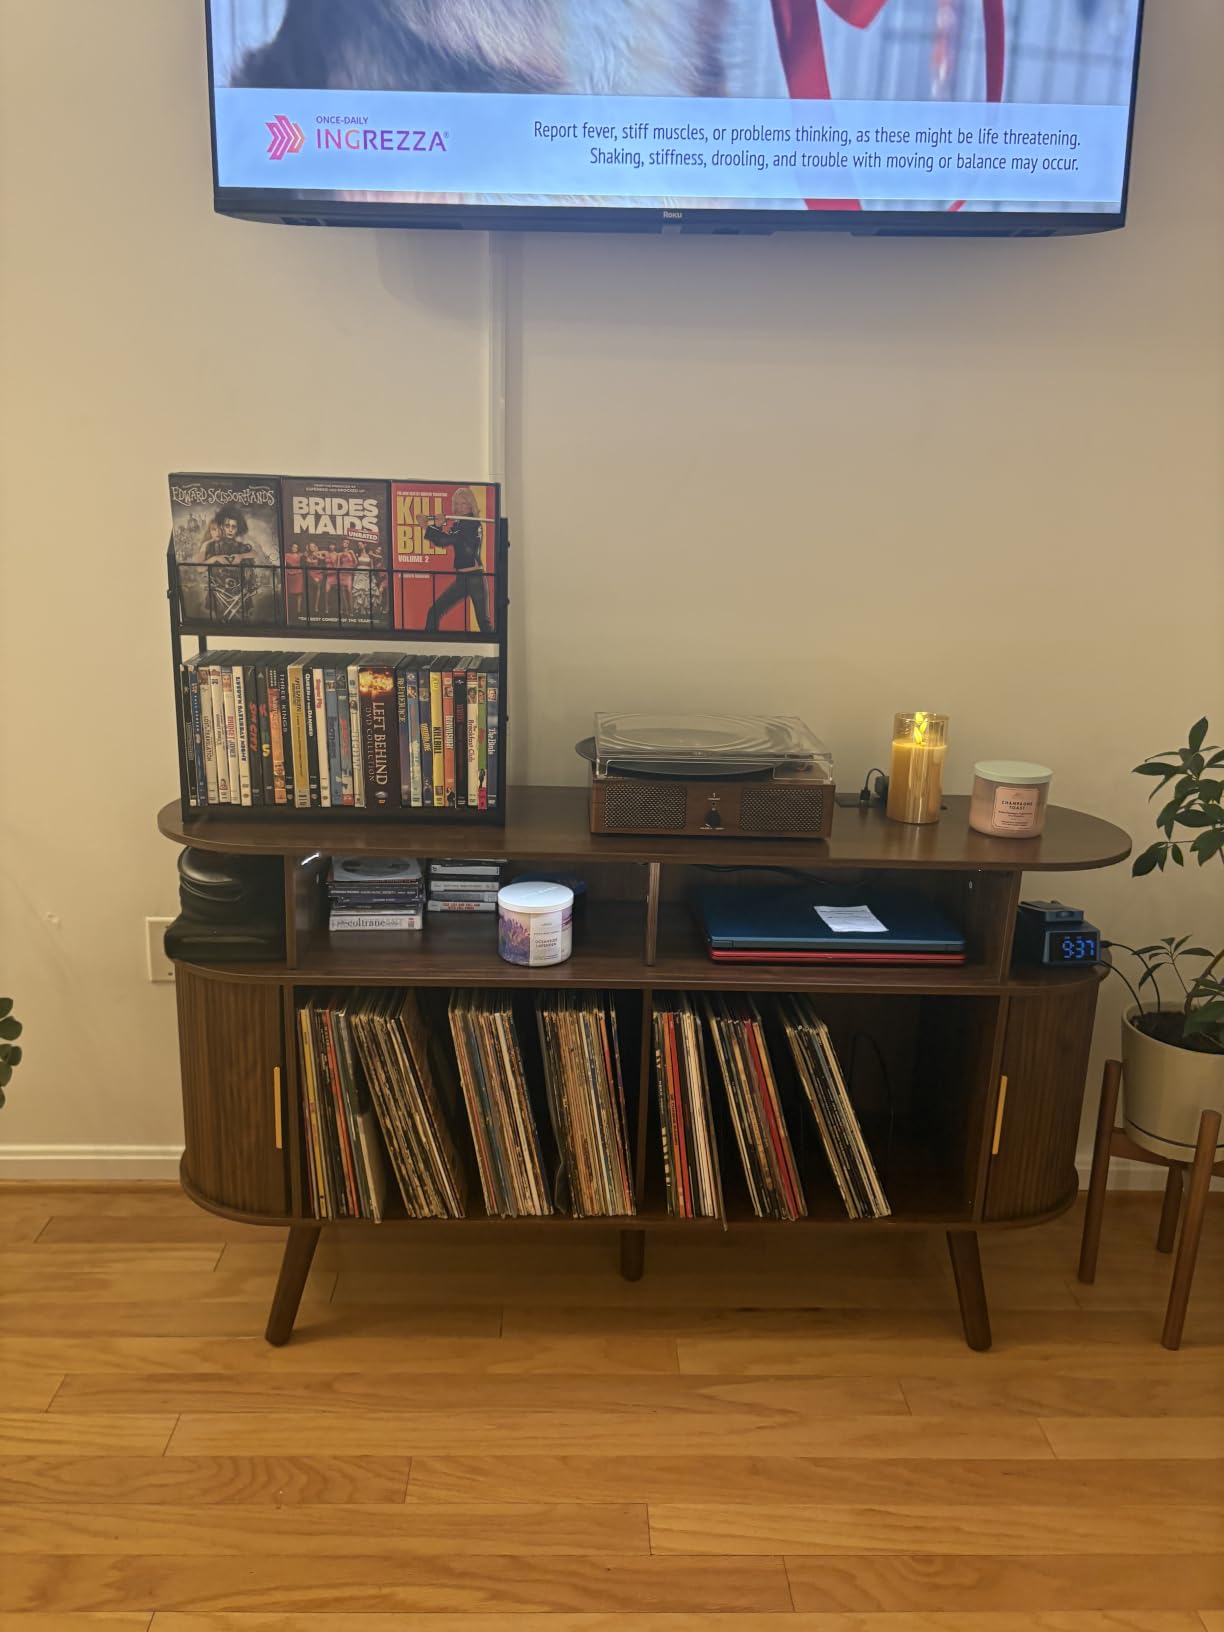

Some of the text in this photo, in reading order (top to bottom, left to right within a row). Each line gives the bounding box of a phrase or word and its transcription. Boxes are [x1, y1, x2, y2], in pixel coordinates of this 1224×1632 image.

[316, 115, 369, 125] ONCE-DAILY
[534, 121, 1081, 149] Report fever, stiff muscles, or problems thinking, as these might be life threatening.
[590, 147, 1079, 174] Shaking, stiffness, drooling, and trouble with moving or balance may occur.
[293, 497, 378, 516] BRIDES
[293, 515, 379, 535] MAIDS
[398, 555, 423, 563] VOLUME
[373, 701, 388, 785] LEFT BEHIND
[488, 728, 496, 739] The
[365, 707, 376, 782] DVD COLLECTION
[347, 918, 386, 928] coltrane
[1062, 939, 1095, 959] 9:37
